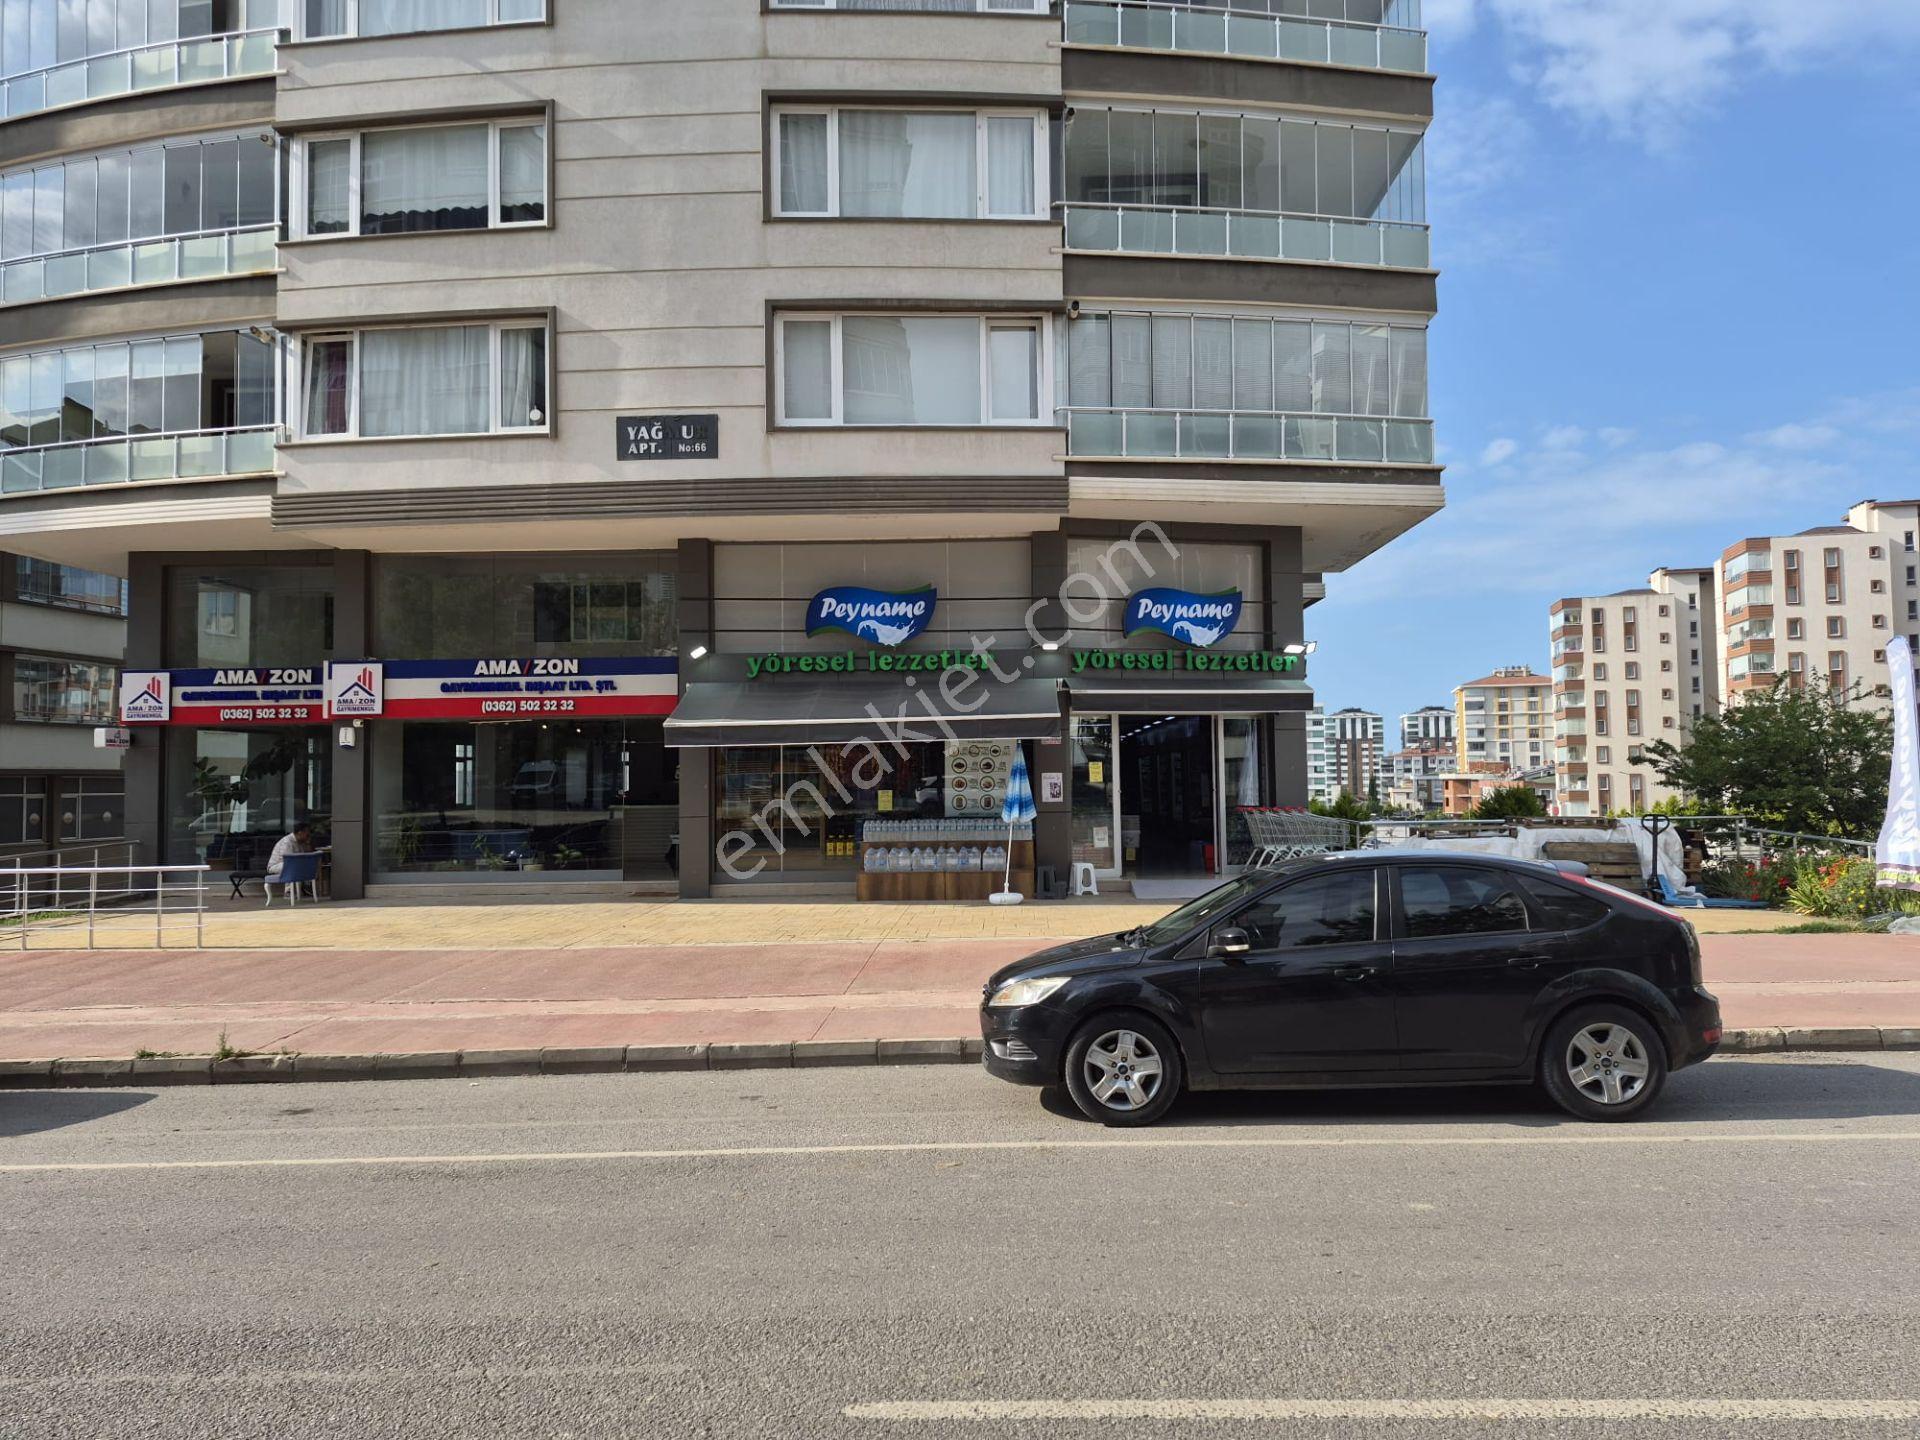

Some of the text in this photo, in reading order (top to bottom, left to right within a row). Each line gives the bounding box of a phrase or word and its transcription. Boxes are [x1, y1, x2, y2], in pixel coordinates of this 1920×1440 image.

[628, 442, 707, 454] APT. No:66
[820, 597, 926, 622] Peyname
[1138, 598, 1234, 623] Peyname
[747, 649, 994, 679] yöresel lezzetler
[1072, 648, 1298, 673] yöresel lezzetler
[220, 708, 308, 721] (0362) 502 32 32
[481, 700, 575, 714] (0362) 502 32 32
